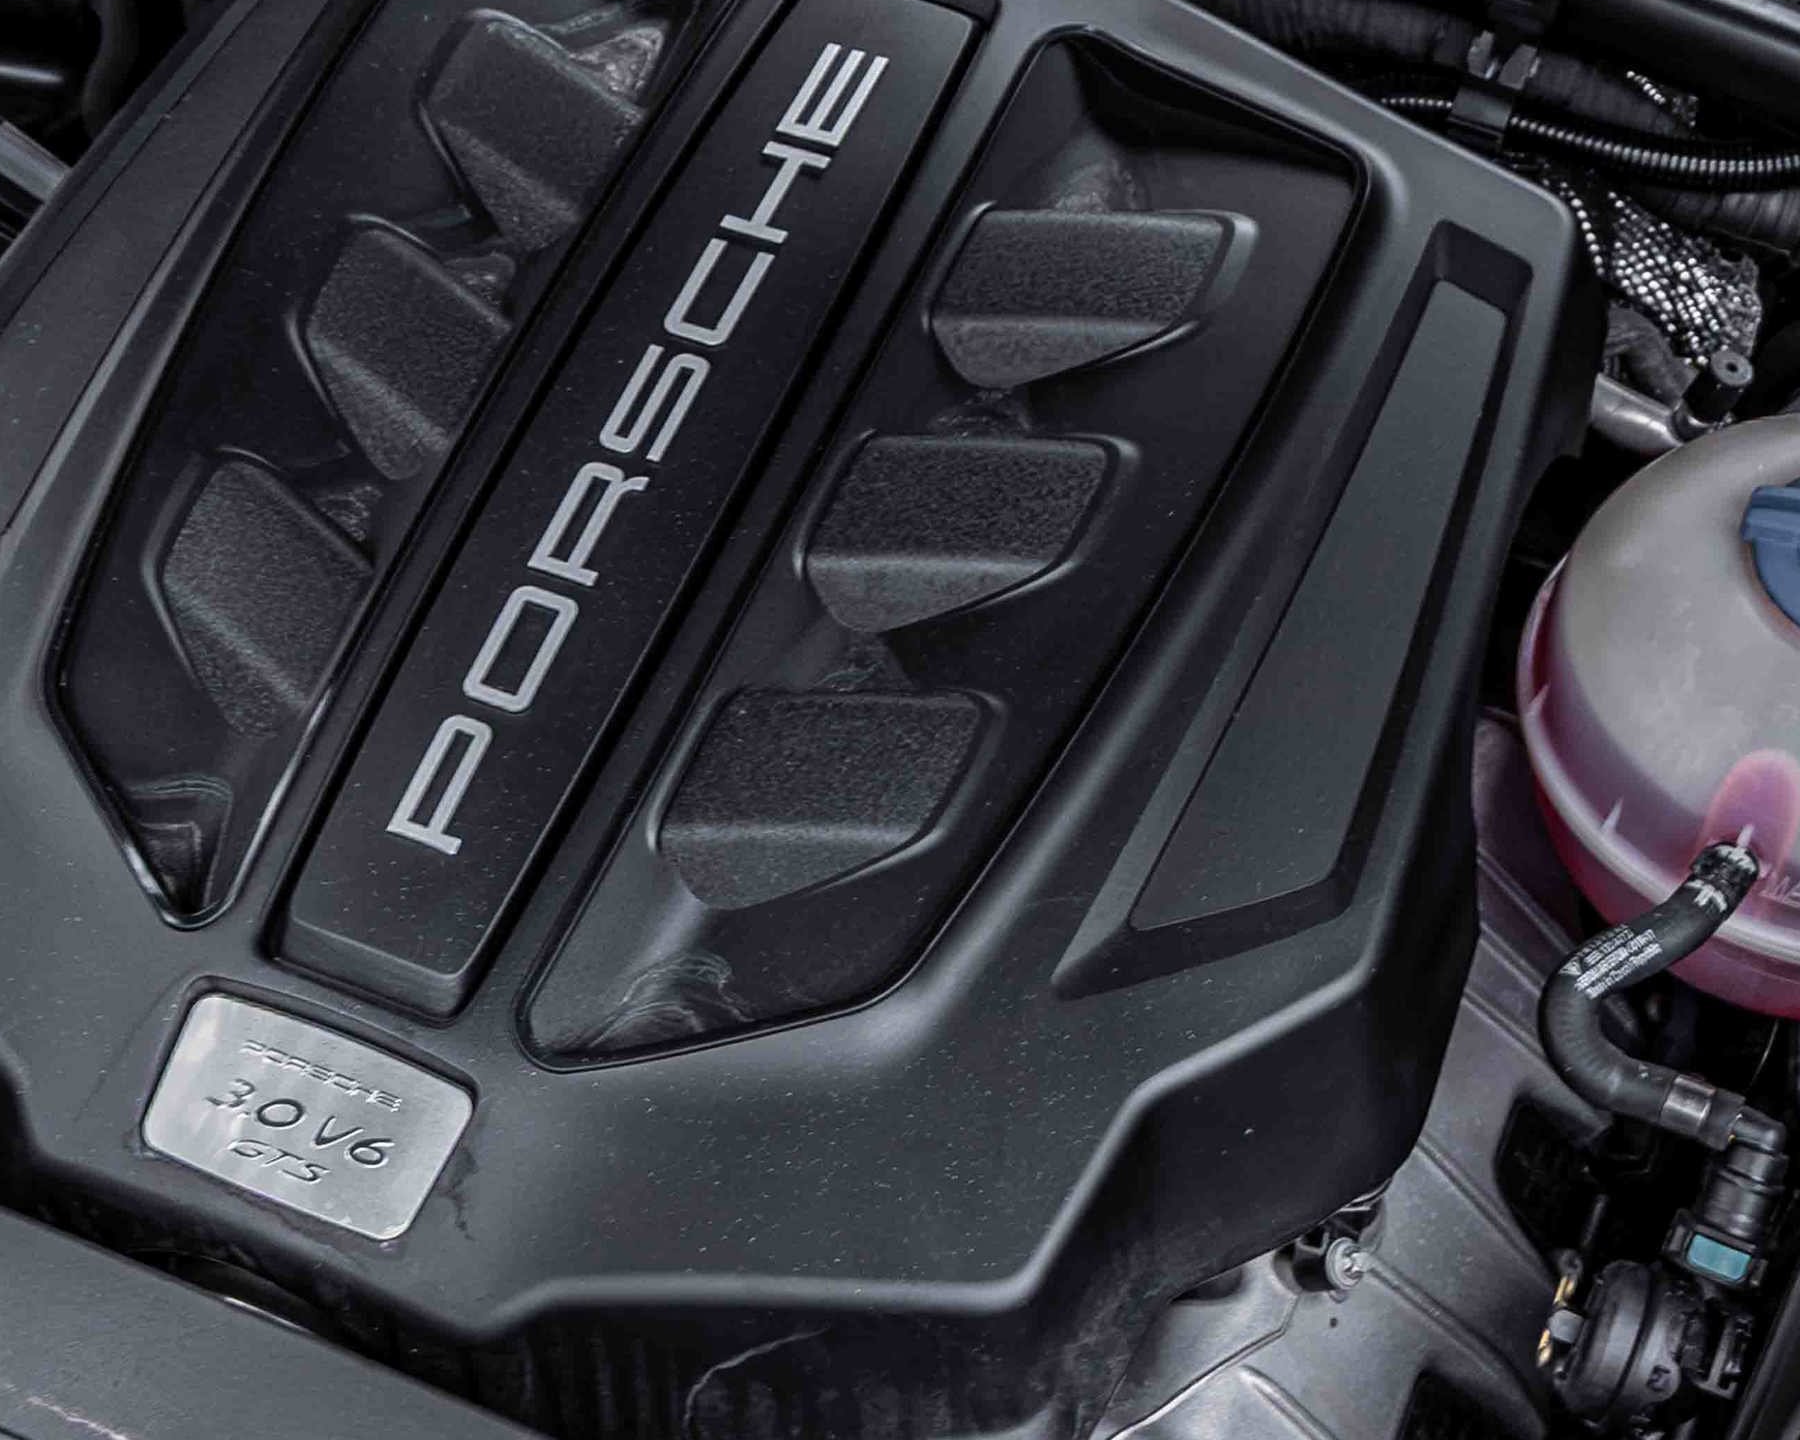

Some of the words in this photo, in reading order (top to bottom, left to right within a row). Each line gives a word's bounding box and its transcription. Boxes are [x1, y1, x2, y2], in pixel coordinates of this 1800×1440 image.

[386, 42, 889, 857] PORSCHE
[239, 1039, 402, 1113] PORSCHE
[206, 1077, 306, 1131] 3.0
[313, 1114, 397, 1168] V6
[227, 1138, 330, 1184] GTS
